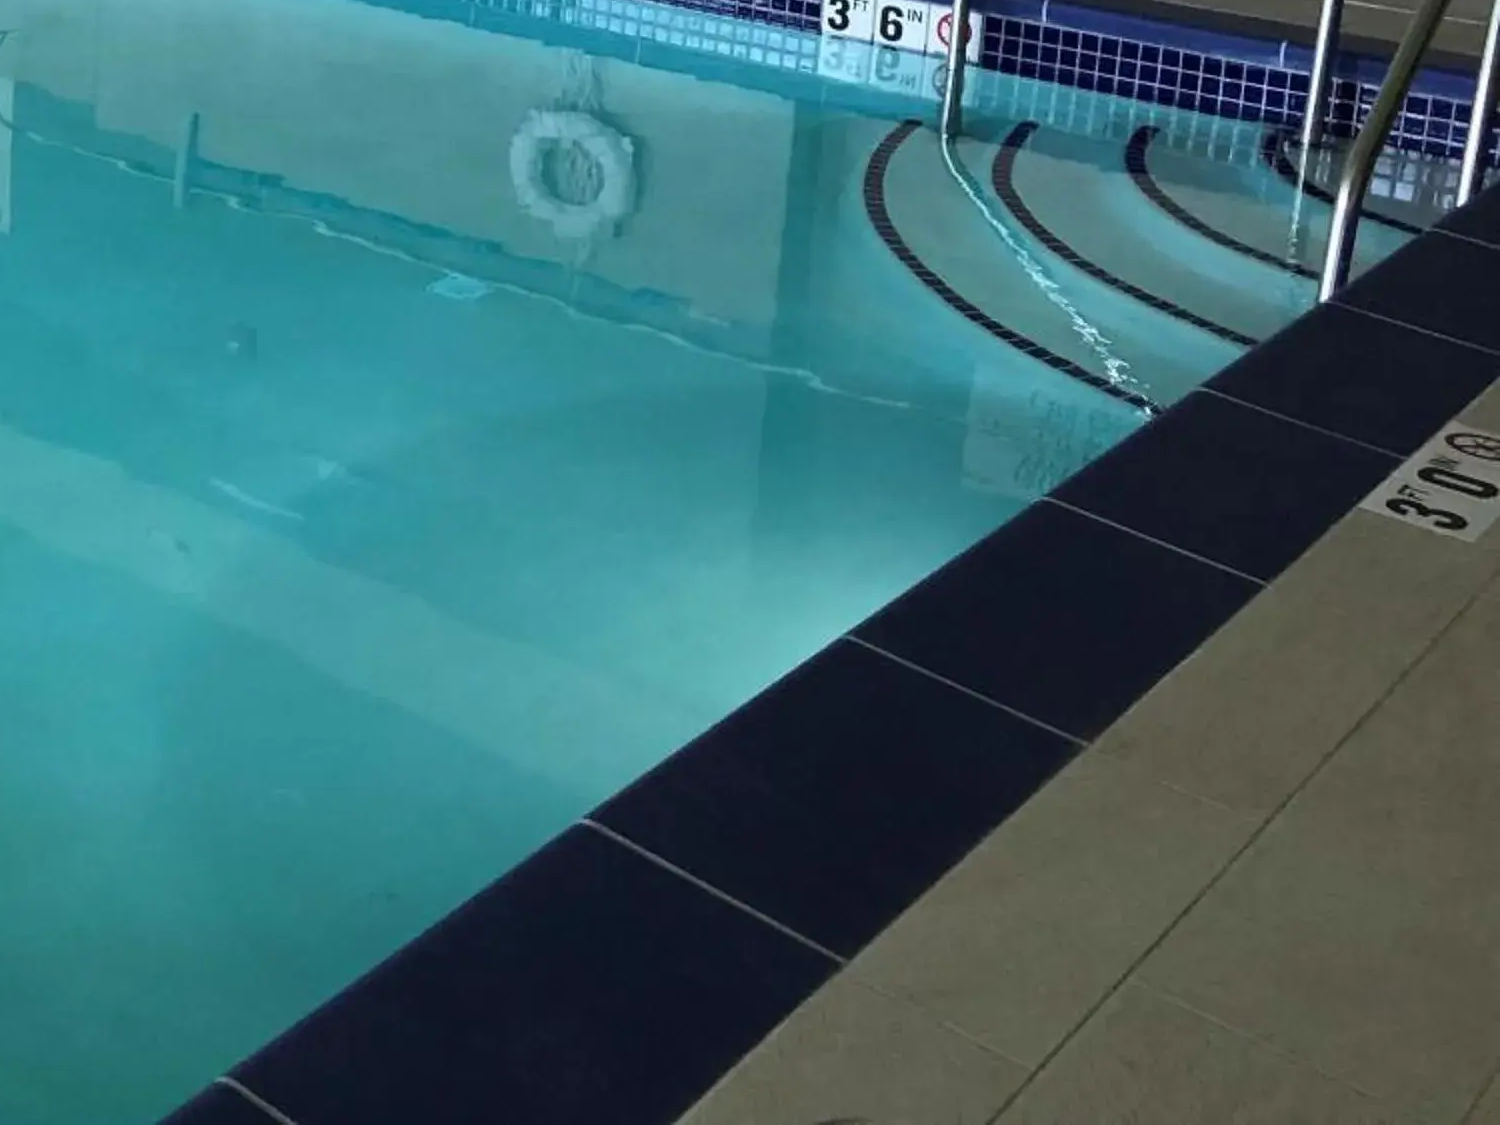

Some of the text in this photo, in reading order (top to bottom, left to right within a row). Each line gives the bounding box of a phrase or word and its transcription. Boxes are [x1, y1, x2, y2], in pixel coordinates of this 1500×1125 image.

[879, 5, 904, 42] 6
[907, 9, 923, 23] IN
[1385, 498, 1468, 530] 3
